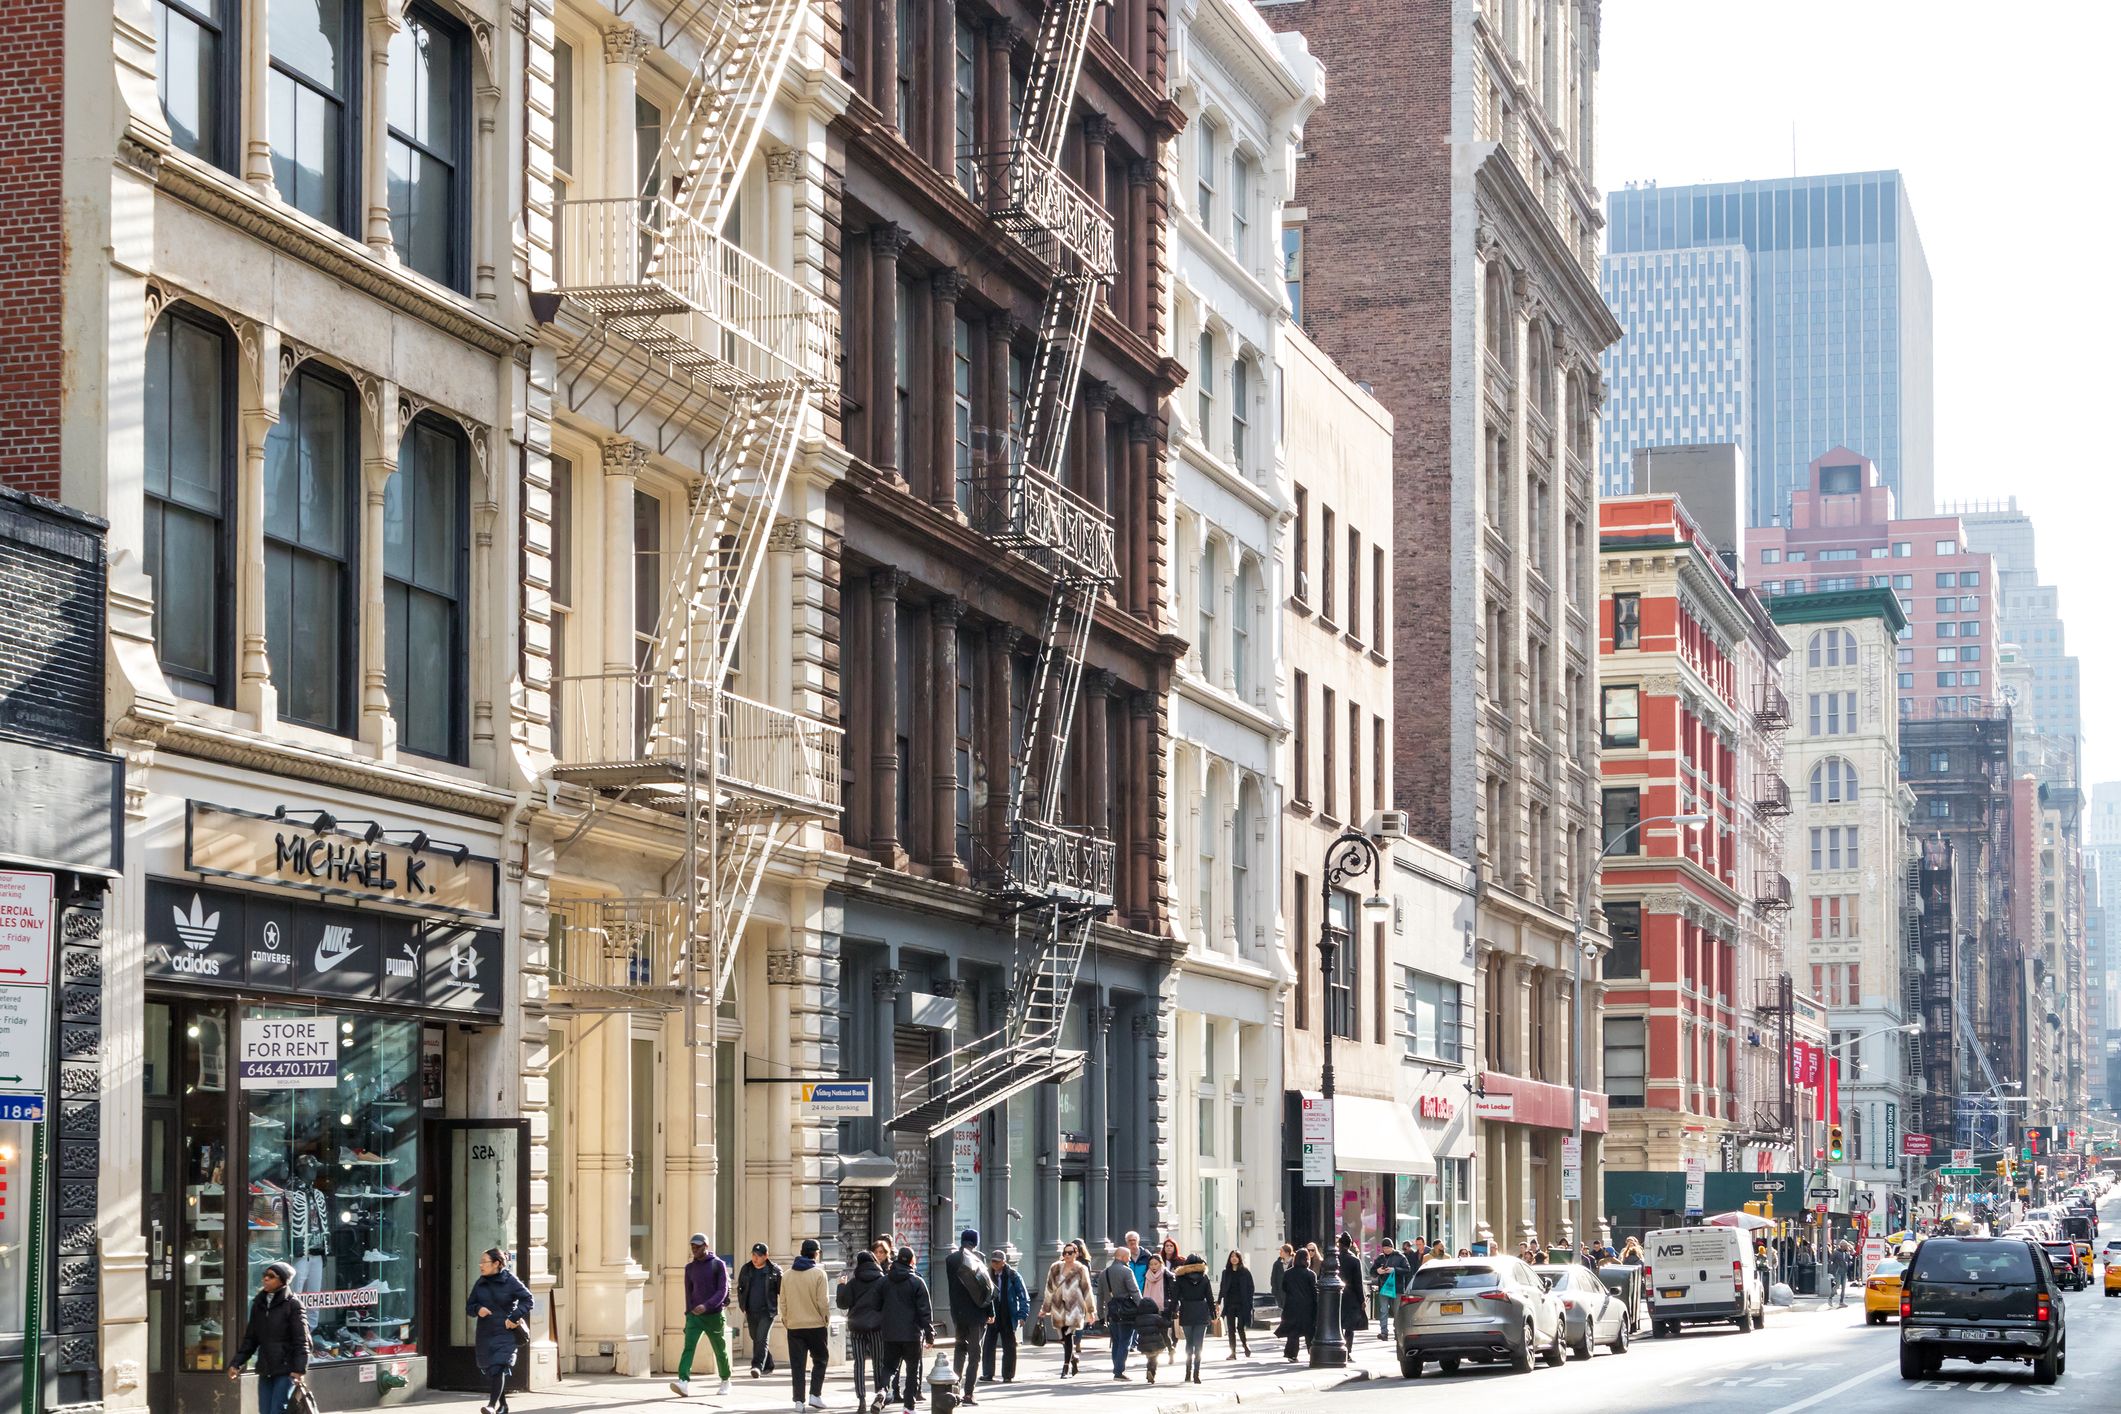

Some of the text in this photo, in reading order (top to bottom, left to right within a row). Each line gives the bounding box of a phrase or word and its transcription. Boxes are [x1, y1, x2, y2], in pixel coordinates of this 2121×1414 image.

[275, 832, 437, 895] MICHAEL K.
[20, 918, 45, 929] ONLY
[7, 933, 31, 943] Friday
[322, 924, 353, 953] NIKE
[172, 952, 220, 976] adidas
[251, 950, 292, 965] CONVERSE
[386, 957, 414, 978] PUMA
[4, 1016, 28, 1026] Friday
[262, 1023, 316, 1039] STORE
[248, 1041, 329, 1057] FOR RENT
[1793, 1047, 1802, 1068] UFC
[247, 1062, 330, 1077] 646.470.1717
[831, 1089, 851, 1097] National
[852, 1089, 865, 1097] Bank
[835, 1104, 860, 1112] Banking
[1490, 1103, 1511, 1111] Locker
[1906, 1380, 2067, 1397] BUS
